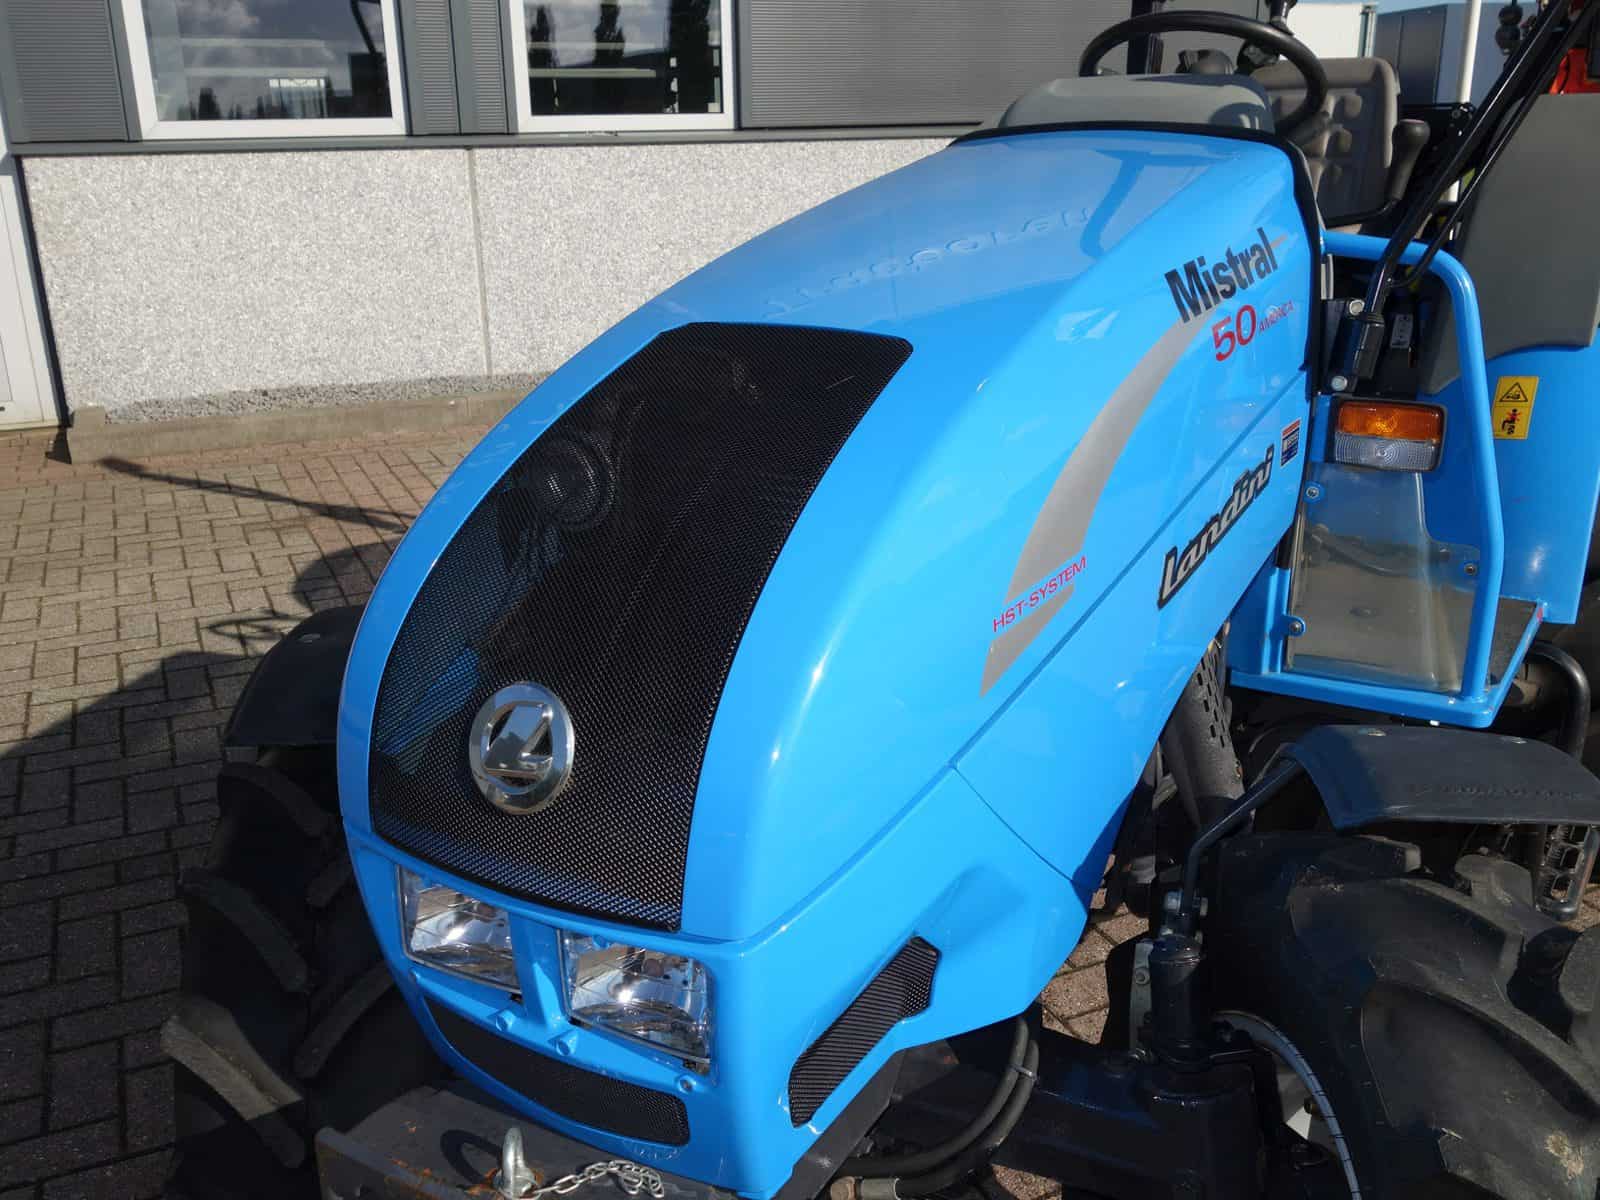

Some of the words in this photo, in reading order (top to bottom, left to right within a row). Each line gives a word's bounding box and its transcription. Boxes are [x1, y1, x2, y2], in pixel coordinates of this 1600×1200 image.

[1164, 227, 1278, 324] Mistral
[1212, 304, 1257, 361] 50
[1157, 443, 1275, 610] Landini
[992, 555, 1087, 632] HST-SYSTEM
